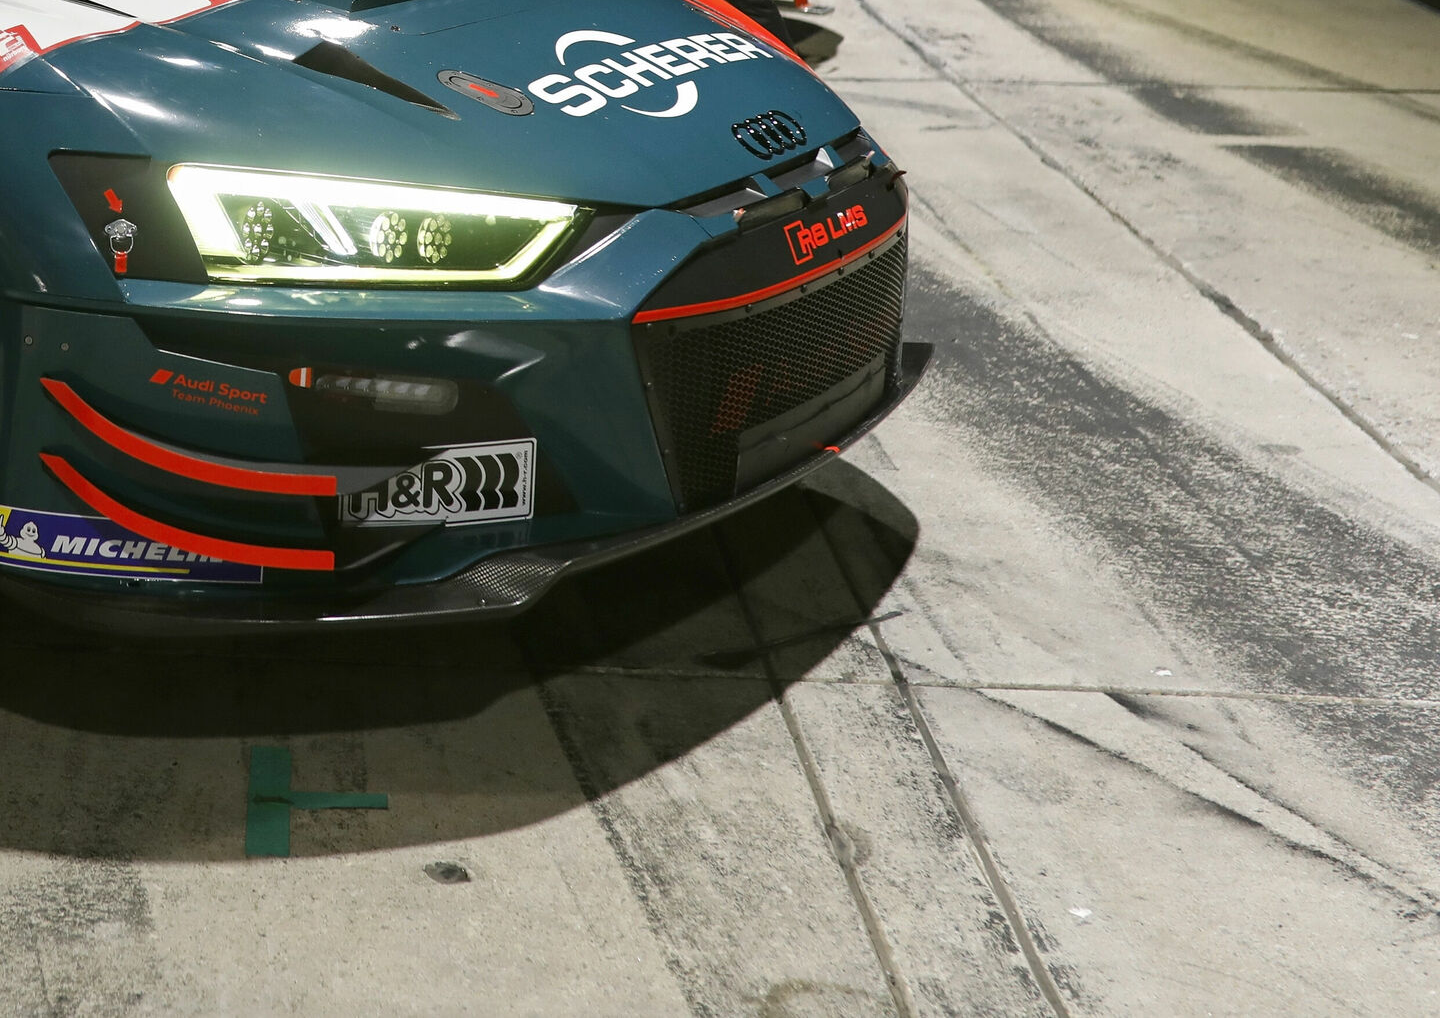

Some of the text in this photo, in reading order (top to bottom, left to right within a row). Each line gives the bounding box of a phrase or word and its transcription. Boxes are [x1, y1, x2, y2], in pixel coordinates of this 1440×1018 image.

[527, 32, 774, 117] SCHERER
[830, 204, 868, 240] LMS
[171, 388, 260, 416] Team Phoenix
[173, 373, 268, 405] Audi Sport
